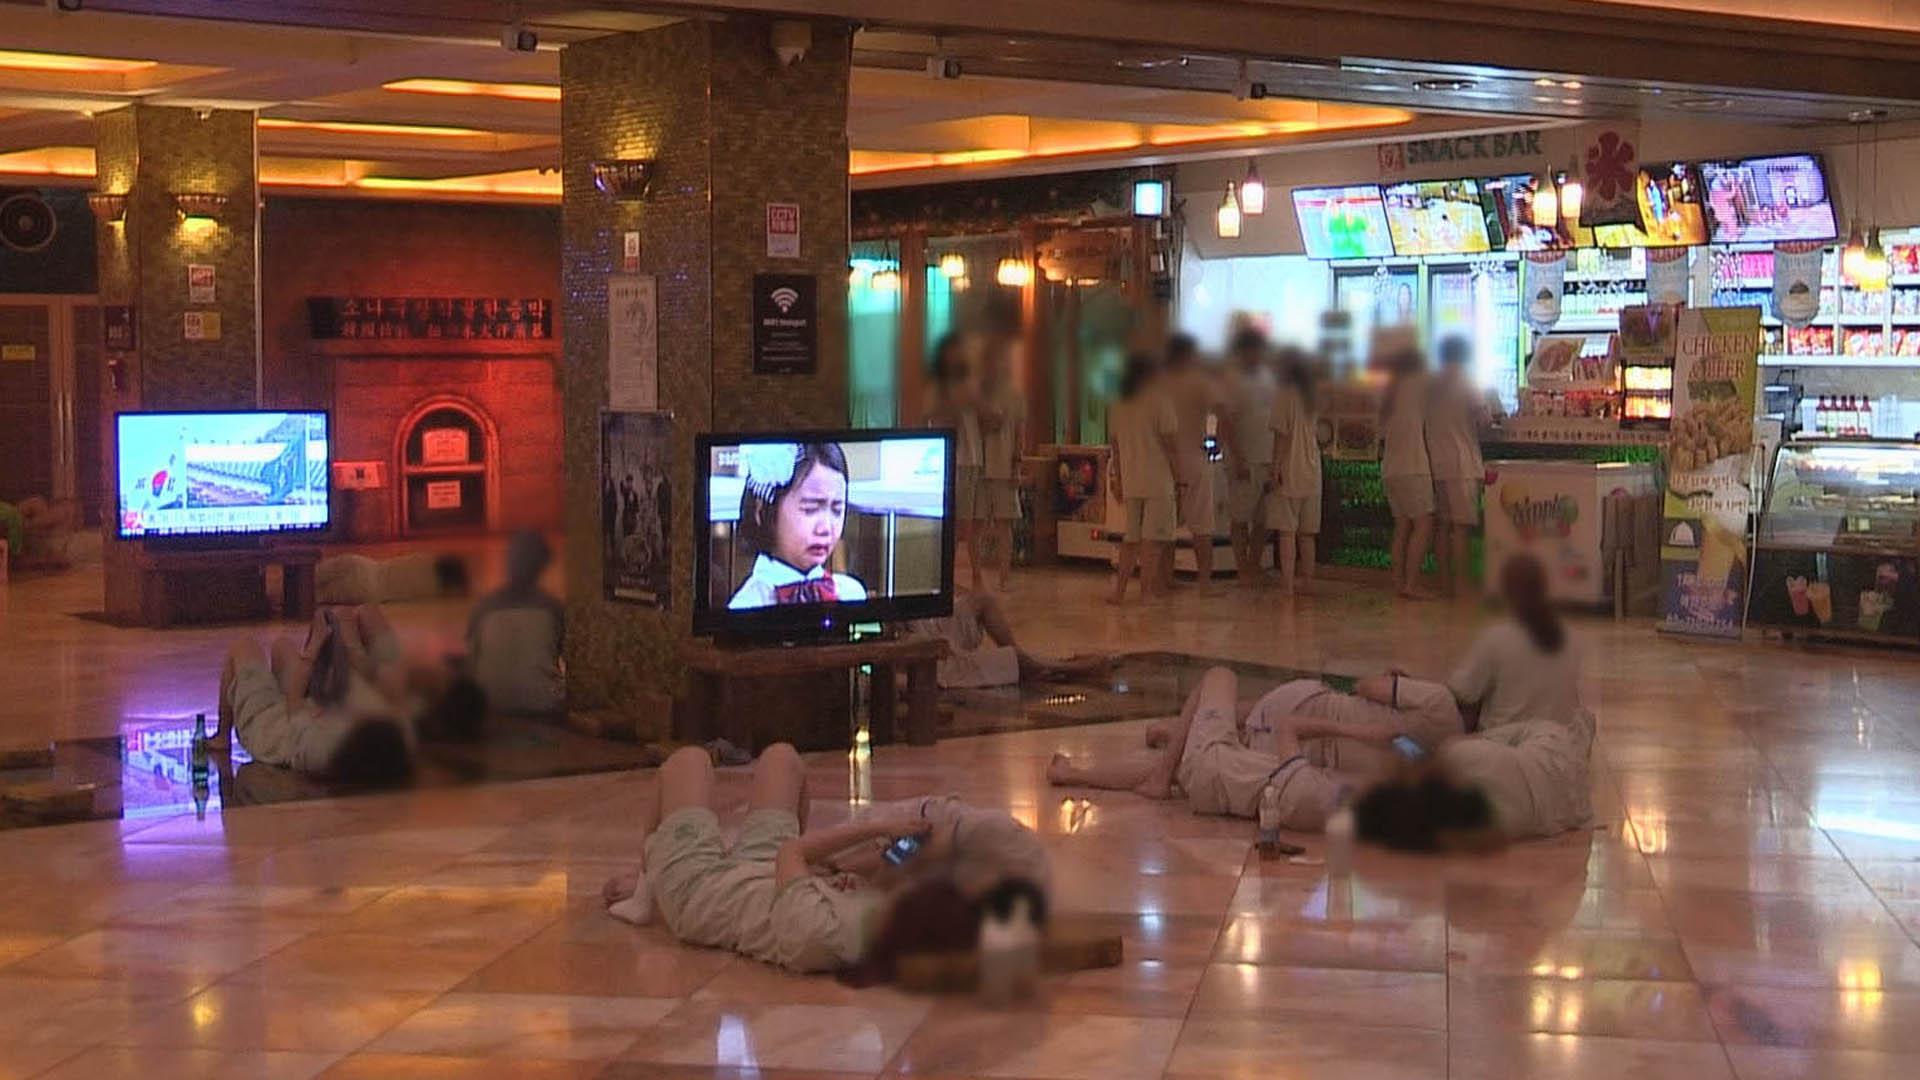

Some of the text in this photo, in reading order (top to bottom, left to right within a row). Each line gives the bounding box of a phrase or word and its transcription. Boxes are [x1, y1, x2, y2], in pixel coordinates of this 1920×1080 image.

[1407, 130, 1542, 165] SNACK BAR
[1682, 334, 1755, 356] CHICKEN
[1705, 359, 1745, 379] BEER
